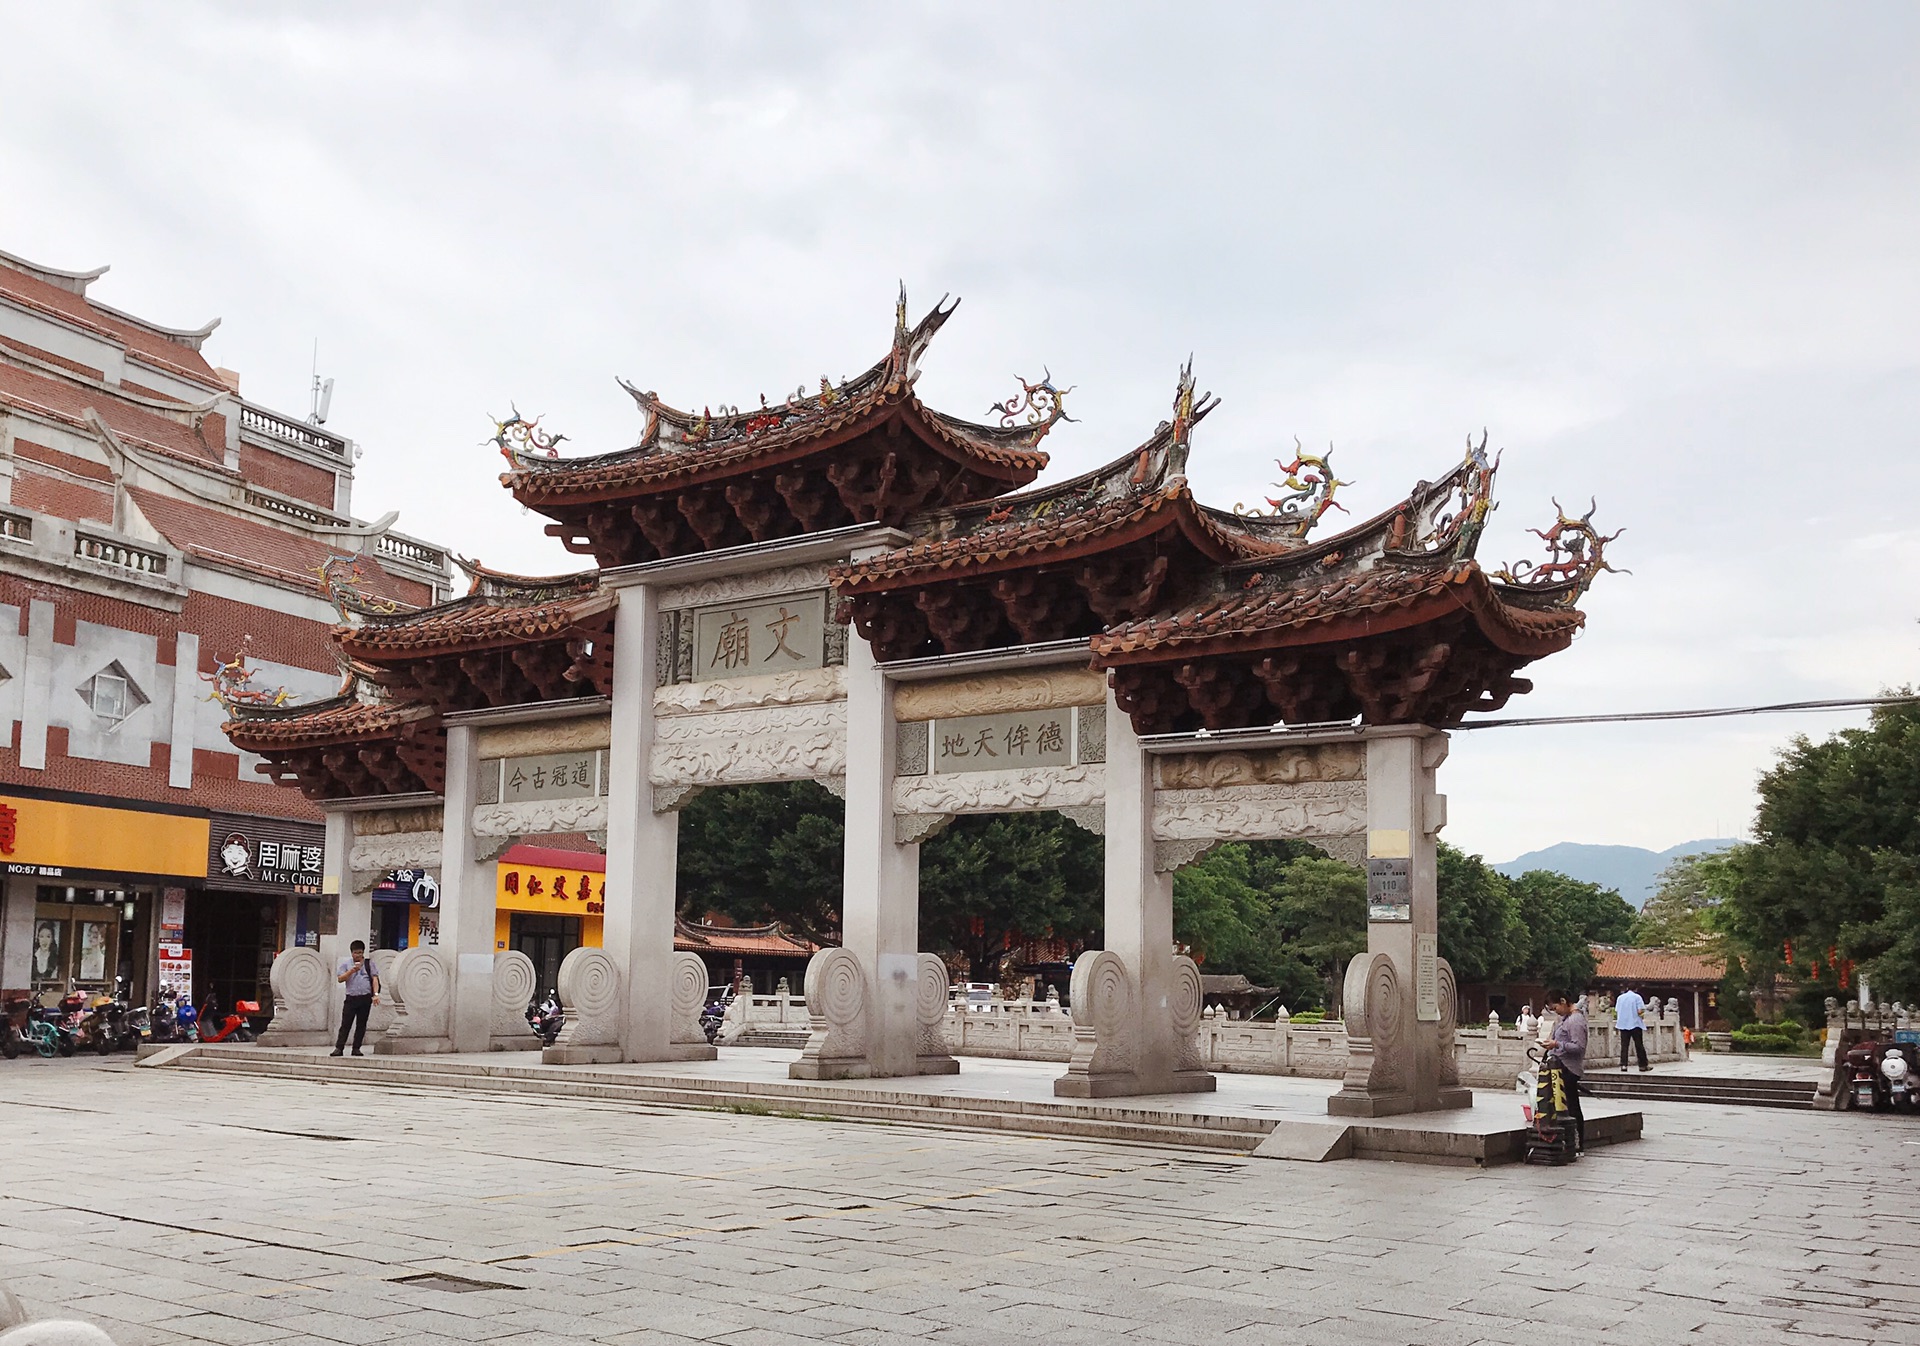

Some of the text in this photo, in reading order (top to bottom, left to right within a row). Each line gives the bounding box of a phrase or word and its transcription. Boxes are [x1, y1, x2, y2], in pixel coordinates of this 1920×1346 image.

[257, 841, 322, 872] 周麻婆
[8, 864, 36, 874] NO:67
[261, 870, 320, 886] Mrs.Chou
